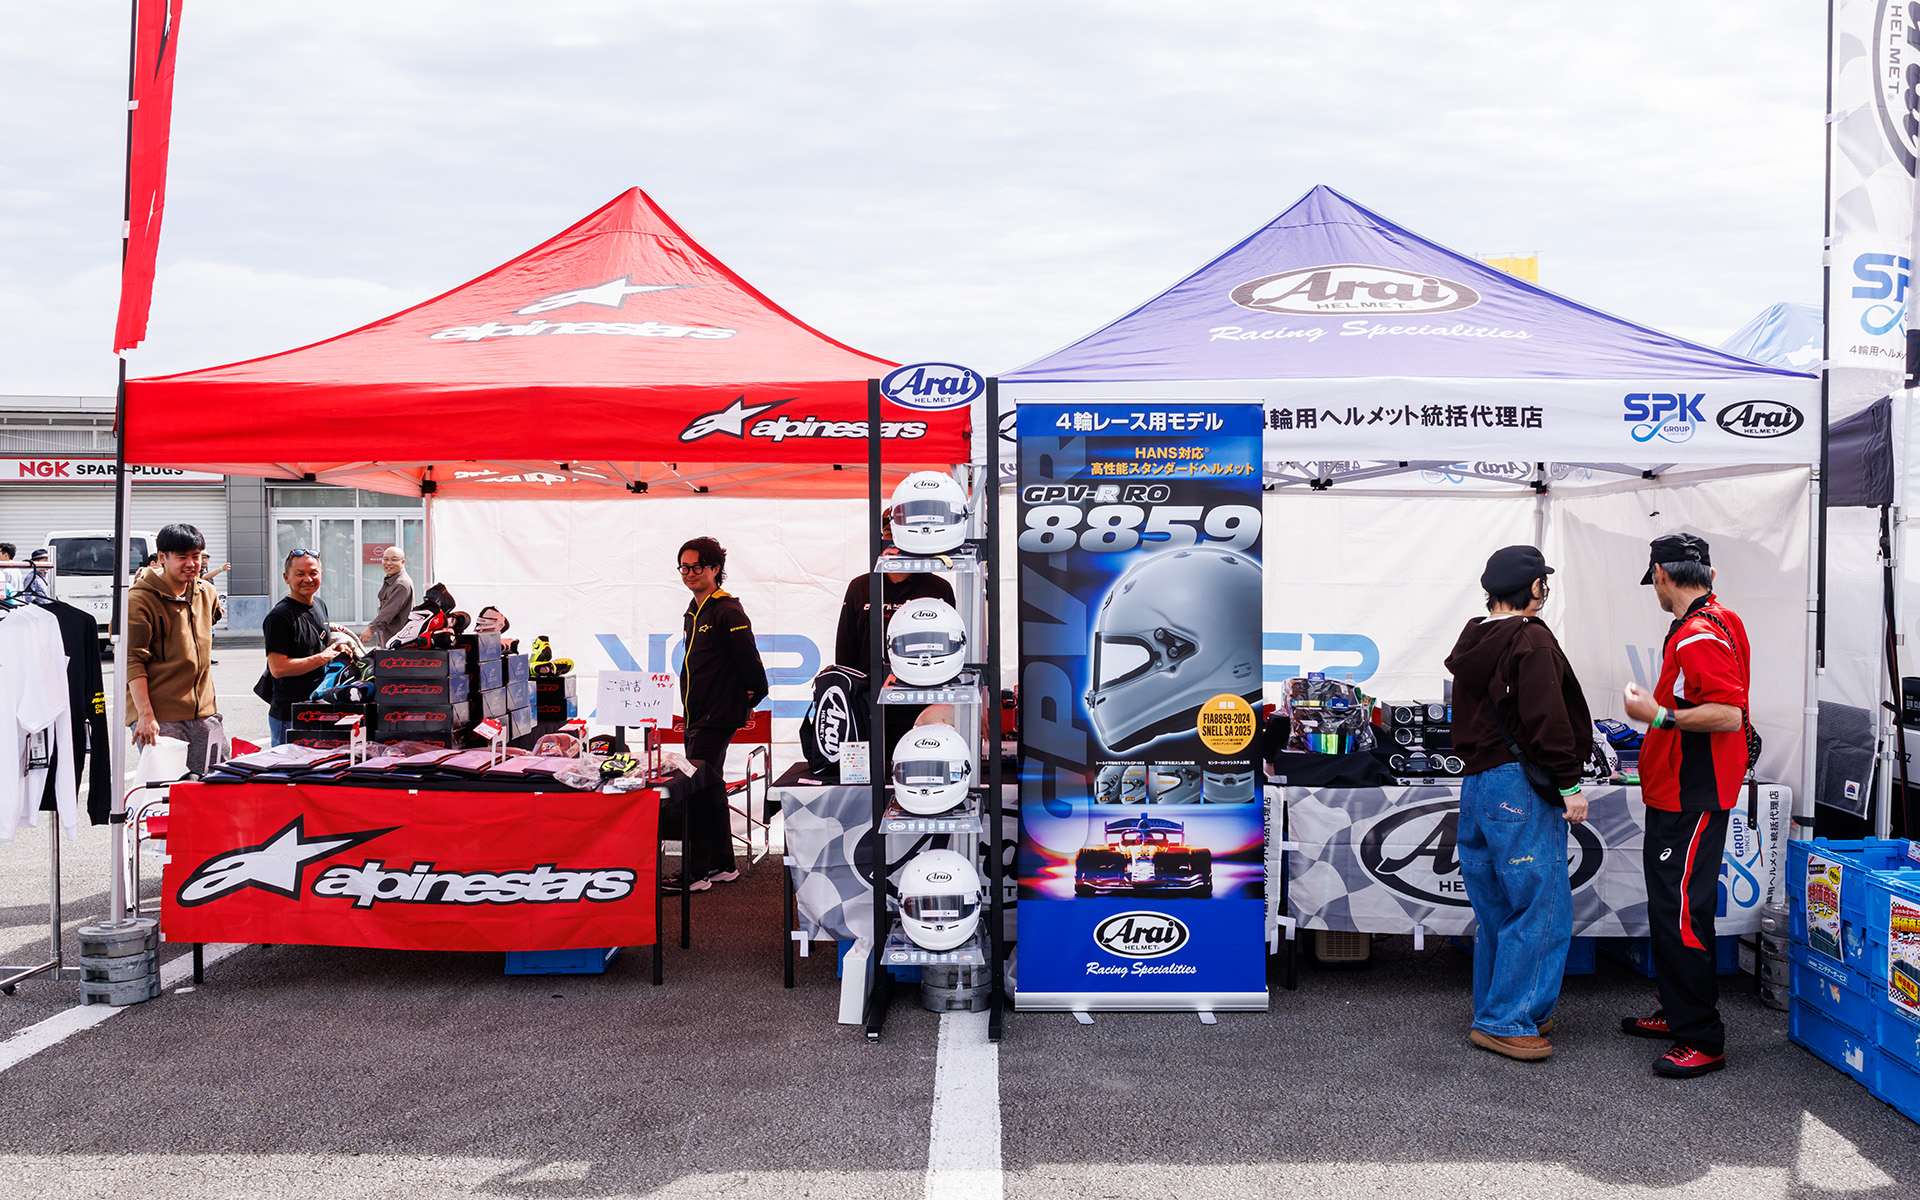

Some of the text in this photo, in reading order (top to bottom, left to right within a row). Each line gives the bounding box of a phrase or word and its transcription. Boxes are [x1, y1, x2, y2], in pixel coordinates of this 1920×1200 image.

[1888, 5, 1902, 94] HELMET
[1251, 270, 1450, 304] Arai
[428, 319, 739, 342] alpinestars
[1209, 320, 1534, 343] Racing Specialities
[888, 367, 974, 397] Arai
[1623, 393, 1707, 422] SPK
[1721, 404, 1794, 429] Arai
[750, 415, 928, 443] alpinesars
[1056, 412, 1224, 432] 4輪レース用モデル
[1663, 425, 1690, 434] GROUP
[19, 461, 70, 478] NGK
[76, 464, 122, 475] SPAR
[1091, 462, 1255, 476] 高性能スタンダードヘルメット
[915, 480, 937, 488] Arai
[1023, 485, 1170, 502] GPV-R RO
[1018, 505, 1262, 553] 8859
[914, 610, 935, 618] Arai
[1203, 713, 1250, 724] FIA8859-2024
[1202, 725, 1251, 736] SNELL SA 2025
[917, 739, 938, 747] Arai
[1733, 817, 1744, 858] GROUP
[311, 859, 639, 910] alpinestars
[928, 872, 950, 880] Arai
[1102, 918, 1176, 944] Arai
[1086, 962, 1198, 979] Racing Specialities
